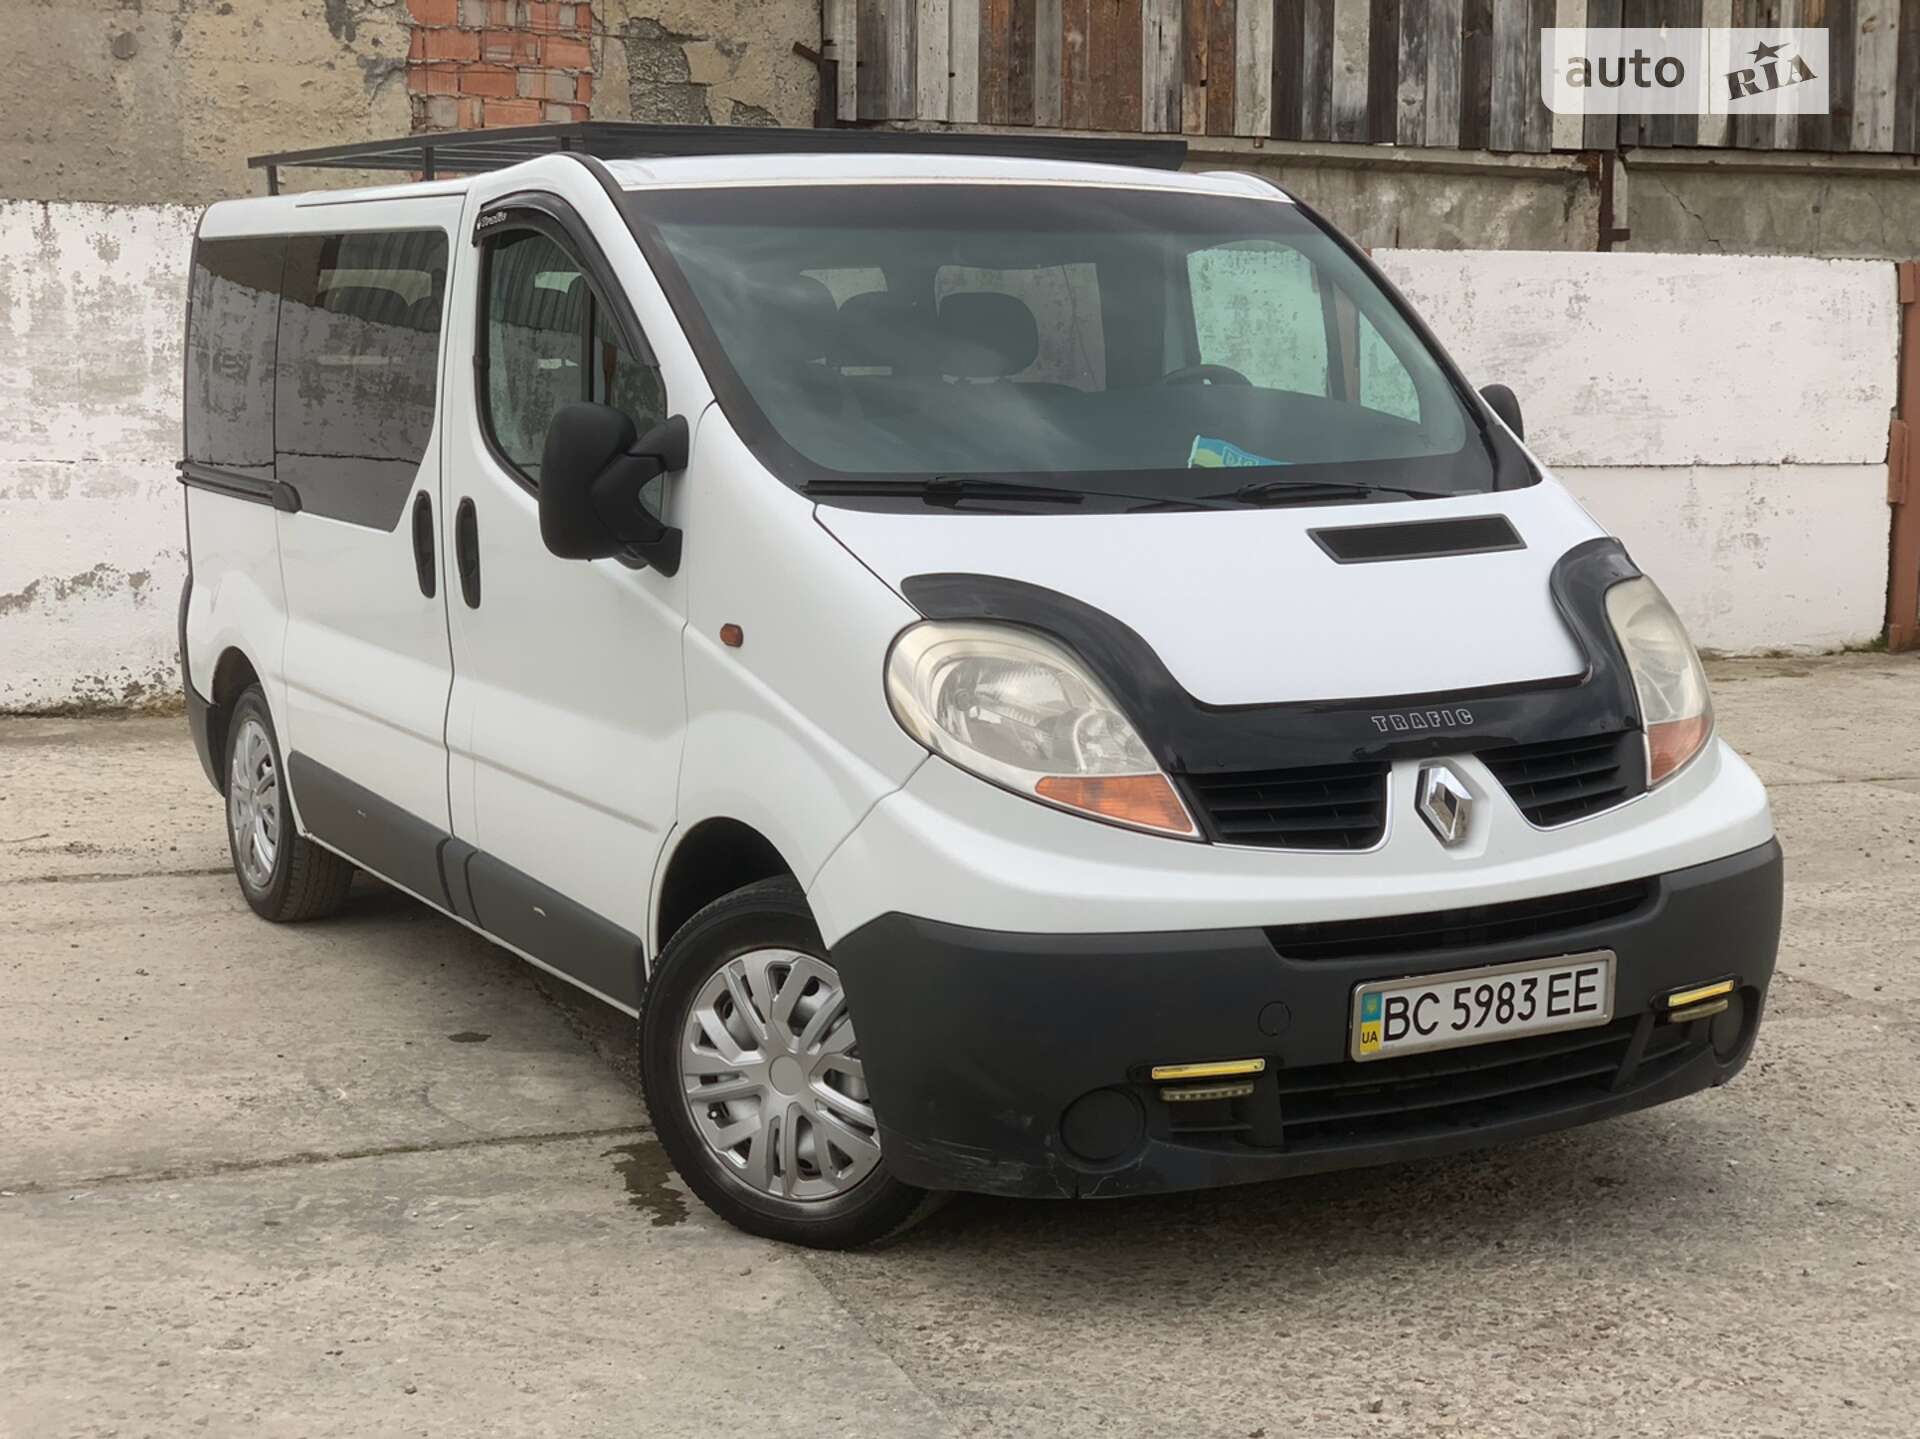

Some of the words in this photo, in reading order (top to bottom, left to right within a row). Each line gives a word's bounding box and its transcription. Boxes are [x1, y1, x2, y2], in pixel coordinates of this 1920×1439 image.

[1371, 708, 1474, 732] TRAFIC
[1383, 992, 1440, 1042] BC
[1451, 977, 1538, 1031] 5983
[1547, 967, 1599, 1017] EE
[1361, 1031, 1378, 1044] UA
